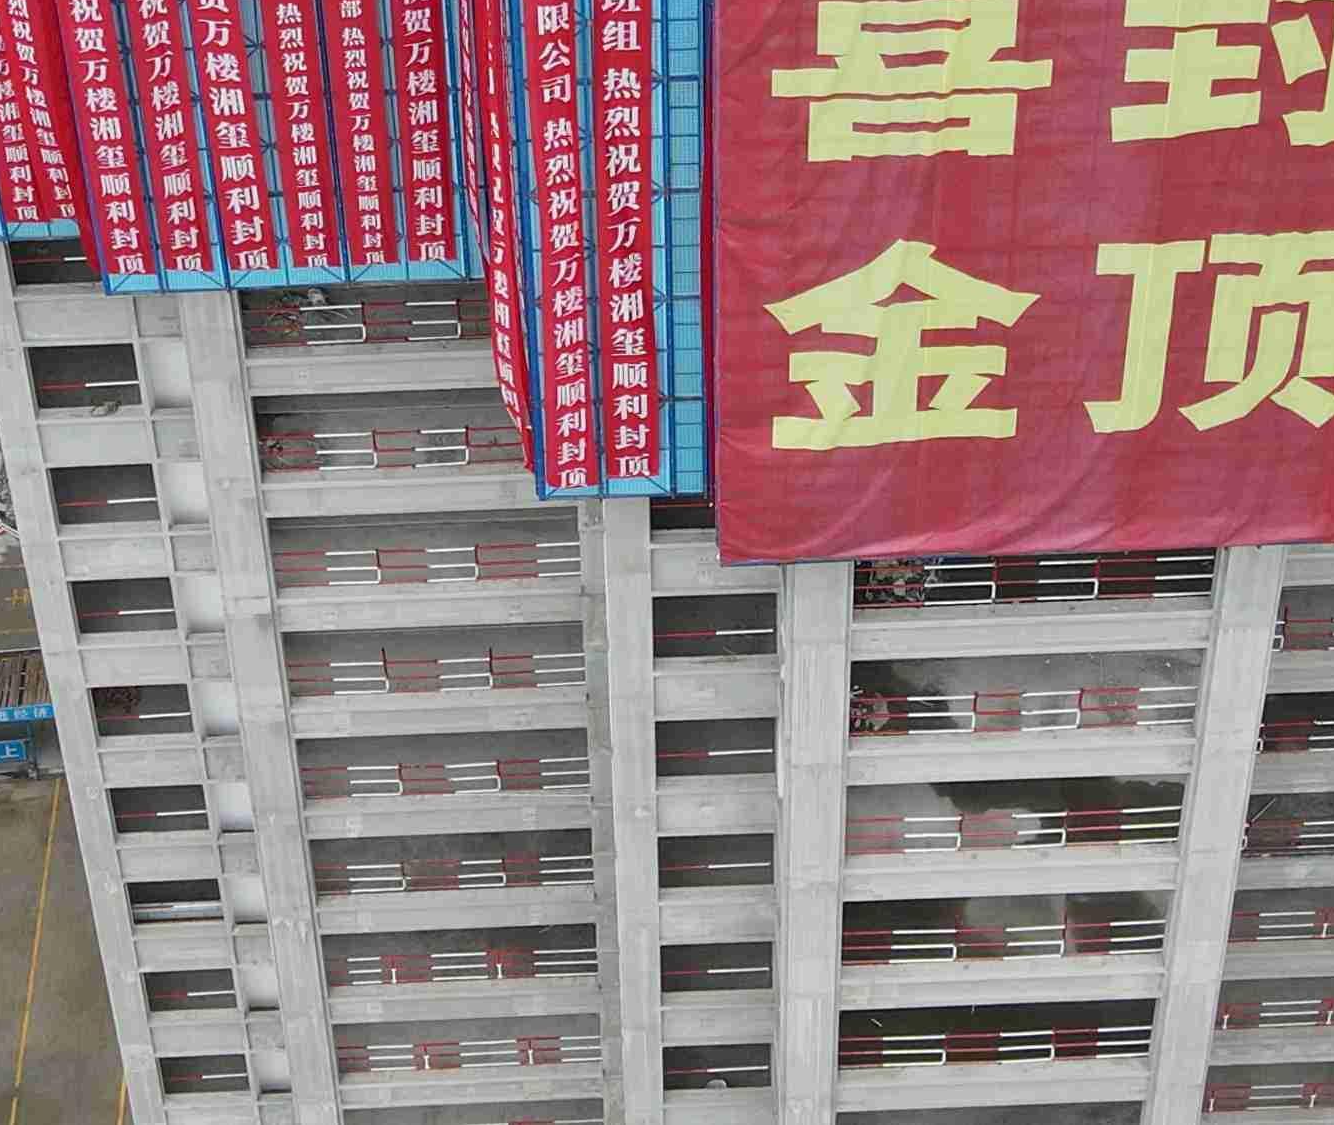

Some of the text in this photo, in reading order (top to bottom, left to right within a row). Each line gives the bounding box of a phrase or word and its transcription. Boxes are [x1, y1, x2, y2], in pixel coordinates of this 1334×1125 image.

[276, 2, 329, 268] 热烈祝贺万楼湘玺顺利封顶
[342, 26, 385, 264] 热烈祝贺万楼湘玺顺利封顶
[603, 68, 651, 477] 热烈祝贺万楼湘玺顺利封顶
[543, 118, 588, 488] 热烈祝贺万楼湘玺顺利封顶
